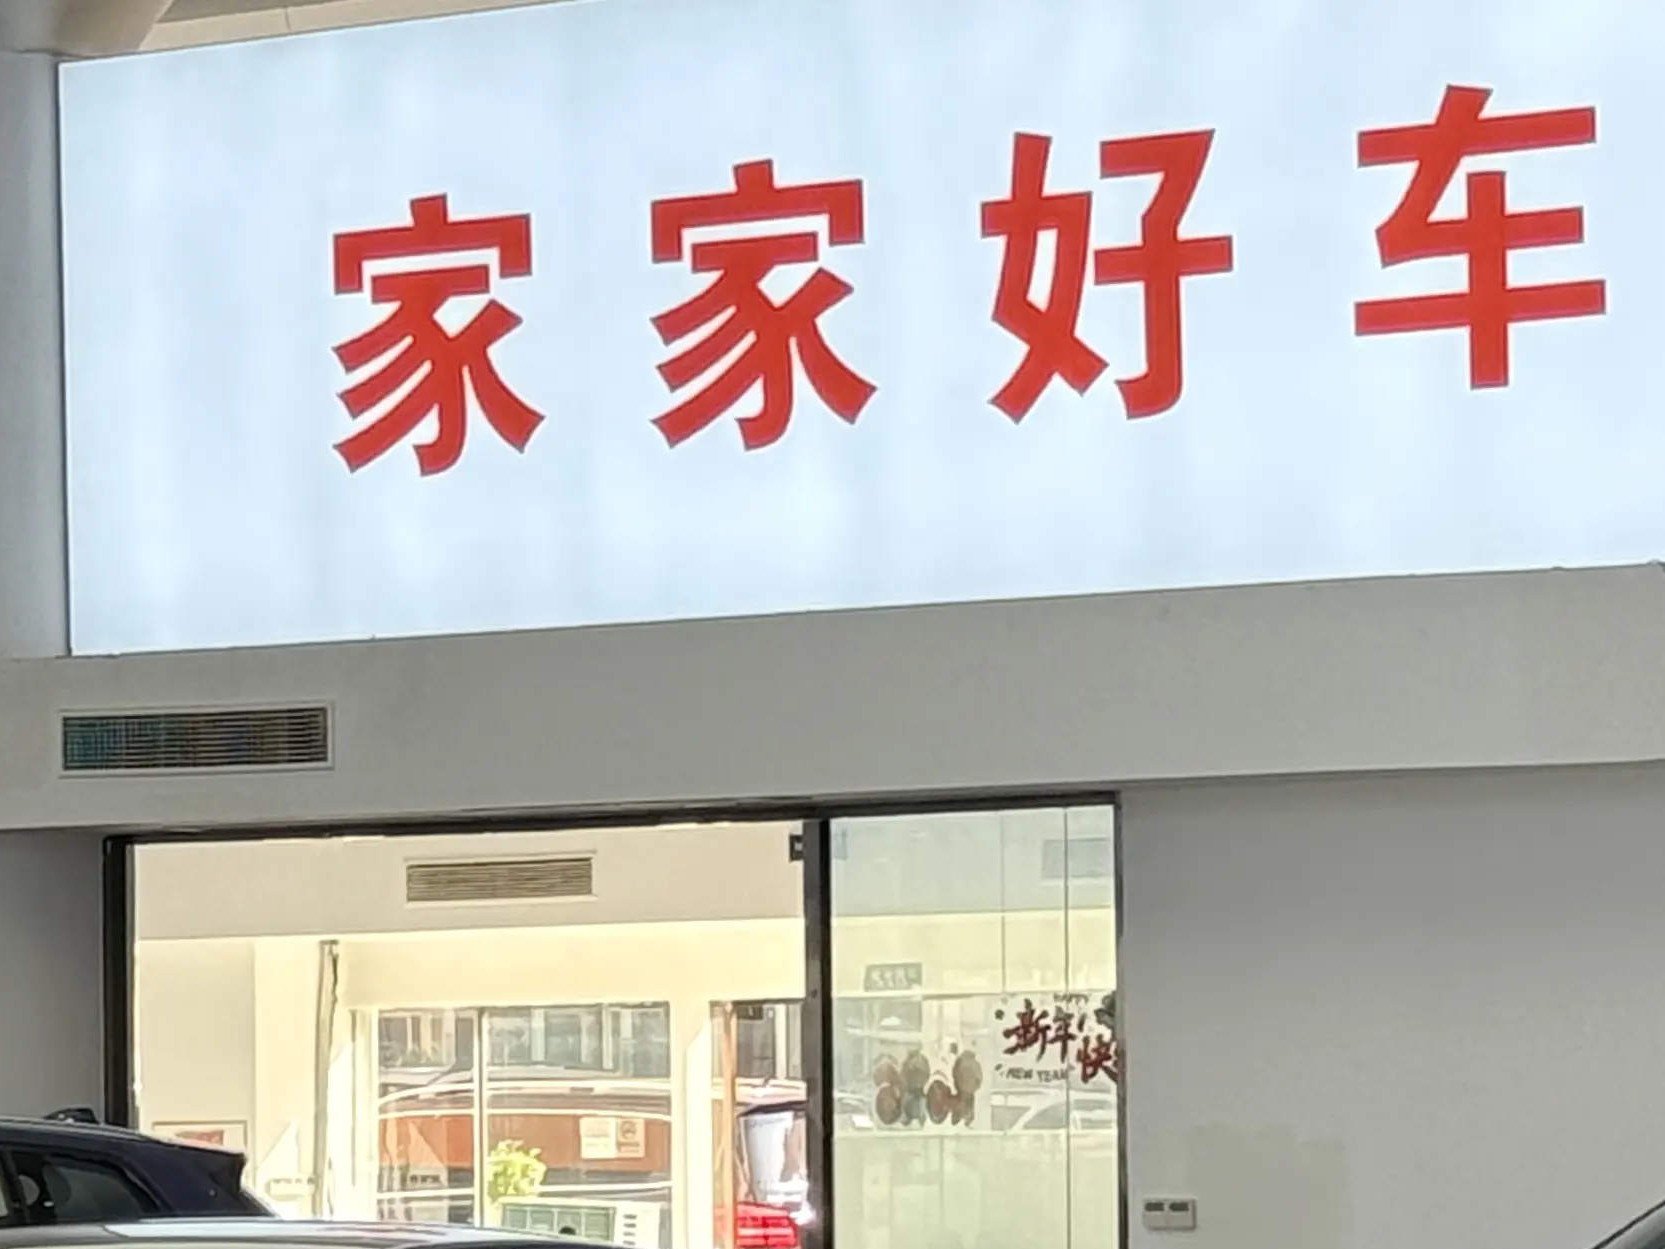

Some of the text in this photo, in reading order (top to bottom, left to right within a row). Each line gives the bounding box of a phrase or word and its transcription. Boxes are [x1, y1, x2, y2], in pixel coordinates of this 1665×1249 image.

[333, 84, 1607, 475] 家家好车
[1002, 998, 1123, 1084] 新年快
